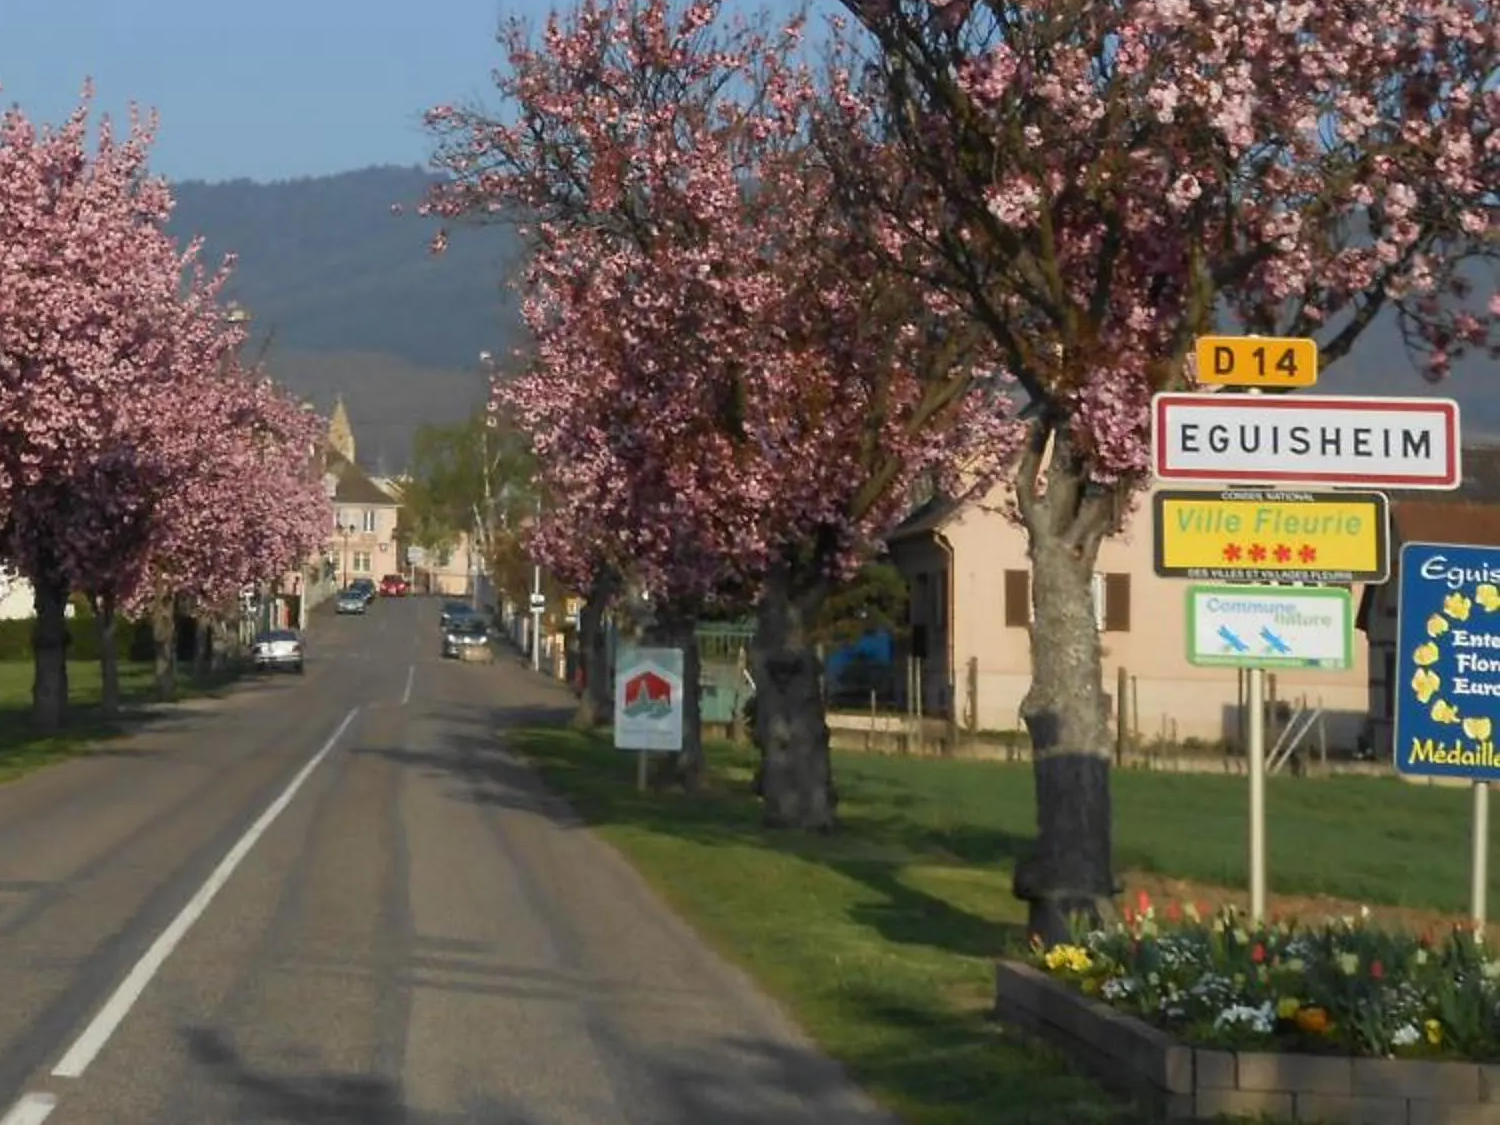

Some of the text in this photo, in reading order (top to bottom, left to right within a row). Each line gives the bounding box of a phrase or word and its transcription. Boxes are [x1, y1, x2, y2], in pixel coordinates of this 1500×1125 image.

[1214, 347, 1298, 377] D 14
[1181, 424, 1431, 459] EGUISHEIM
[1267, 492, 1315, 502] NATIONAL
[1176, 508, 1363, 536] Ville Fleurie
[1206, 597, 1297, 614] Commune
[1274, 612, 1332, 627] nature
